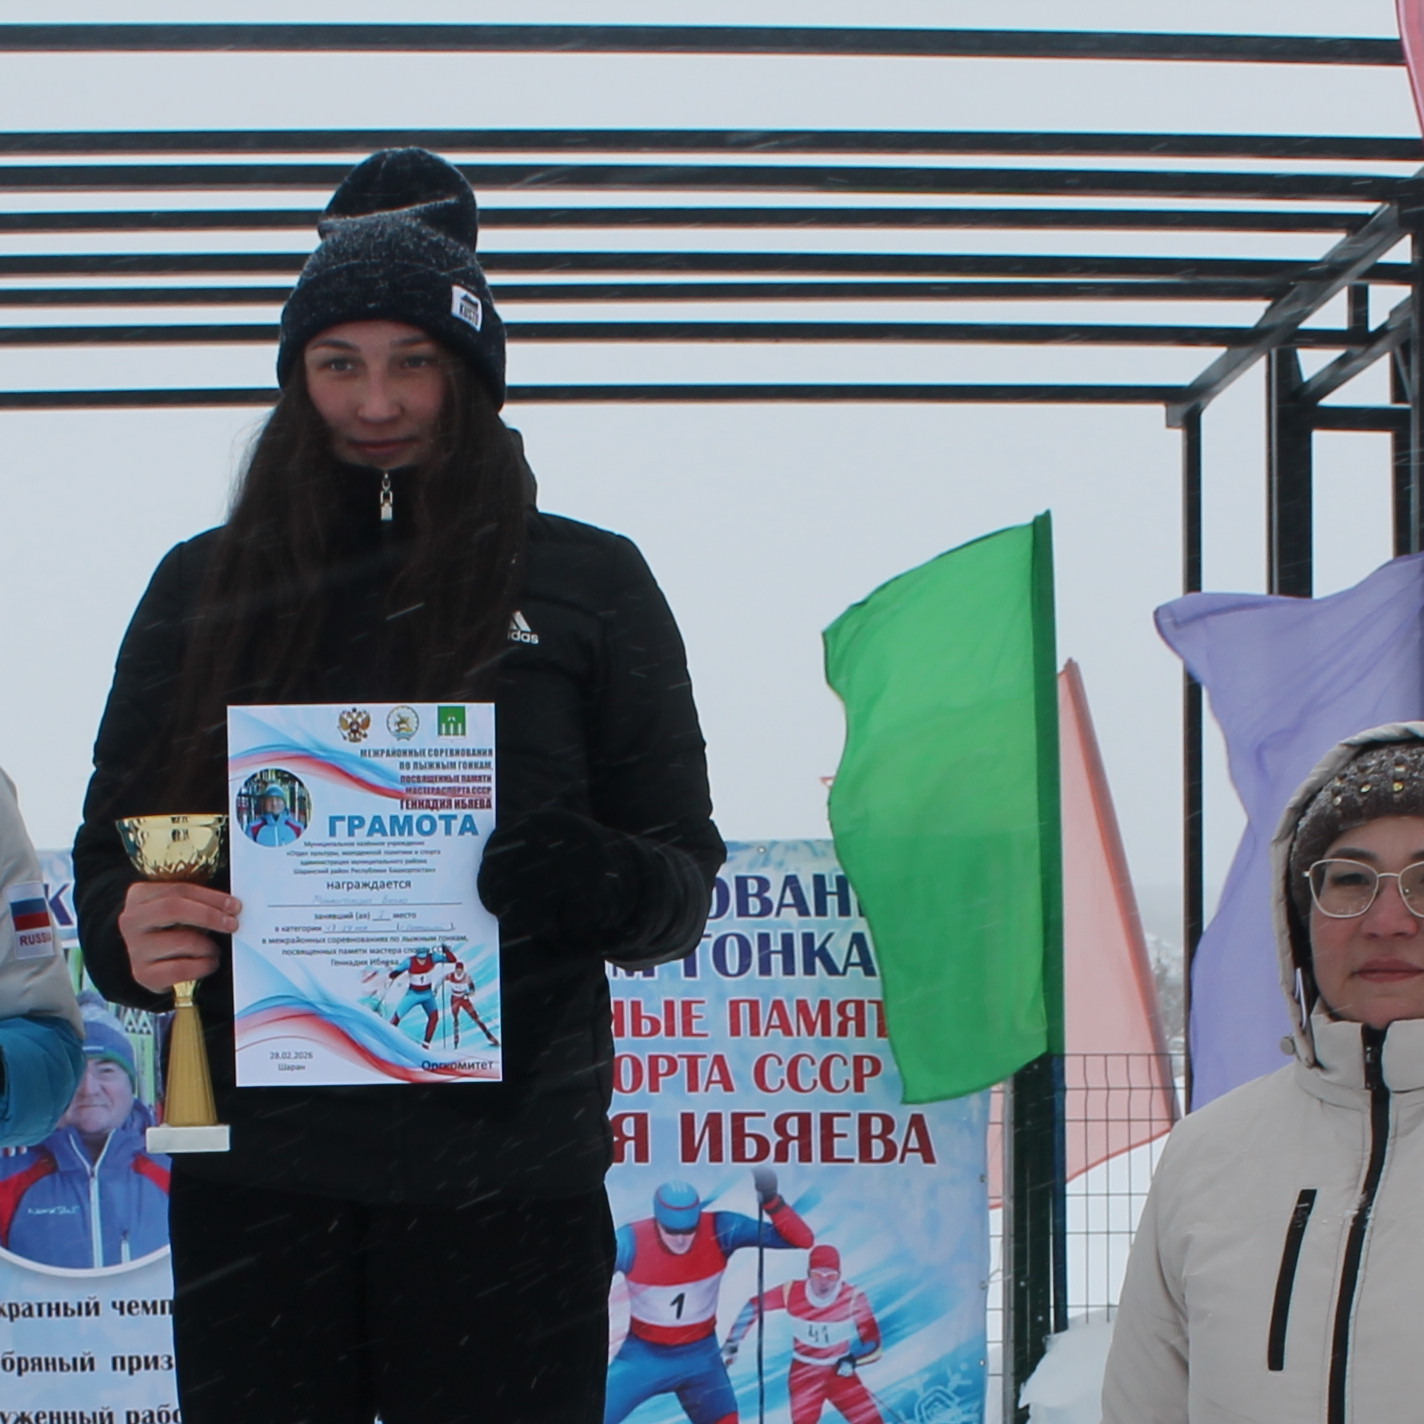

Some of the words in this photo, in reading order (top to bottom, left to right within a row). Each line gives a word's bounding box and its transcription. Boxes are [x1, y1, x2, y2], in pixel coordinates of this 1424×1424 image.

[427, 748, 493, 757] СОРЕВНОВАНИЯ
[329, 814, 480, 838] ГРАМОТА
[327, 880, 411, 890] награждается
[269, 1051, 314, 1060] 28.02.2026
[278, 1063, 306, 1071] Шаран
[421, 1060, 494, 1071] Оргкомитет
[753, 1053, 882, 1093] СССР
[680, 1112, 937, 1164] ИБЯЕВА
[670, 1292, 686, 1321] 1
